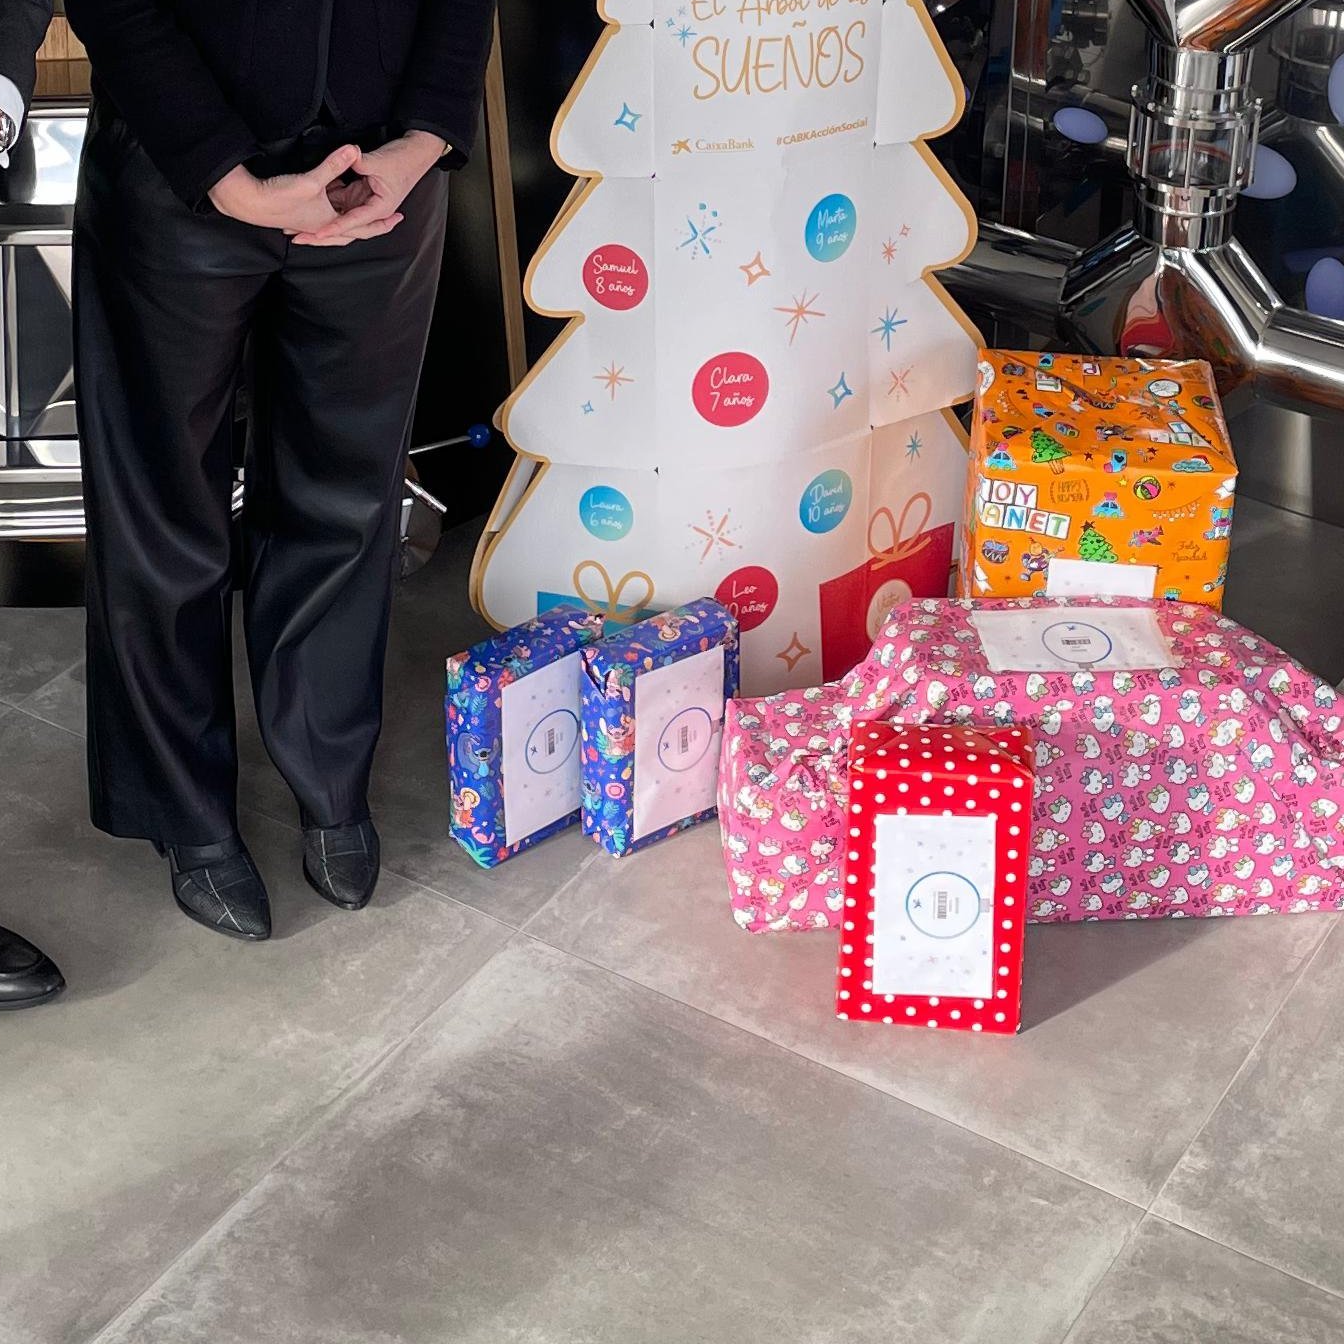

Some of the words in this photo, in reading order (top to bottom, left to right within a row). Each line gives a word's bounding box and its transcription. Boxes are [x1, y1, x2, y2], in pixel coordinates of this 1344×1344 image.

[692, 20, 866, 100] SUEÑOS
[695, 138, 755, 151] CaixaBank
[776, 117, 868, 146] #CABKAcciónSocial
[818, 207, 849, 230] Marta
[816, 232, 824, 252] 9
[827, 230, 849, 245] años
[593, 254, 639, 275] Samuel
[595, 276, 605, 294] 8
[608, 280, 636, 296] años
[710, 366, 754, 389] Clara
[710, 391, 721, 412] 7
[723, 392, 755, 407] años
[590, 512, 599, 526] 6
[808, 505, 821, 524] 10
[984, 504, 1067, 536] ANET
[732, 580, 758, 598] Leo
[741, 600, 769, 614] años
